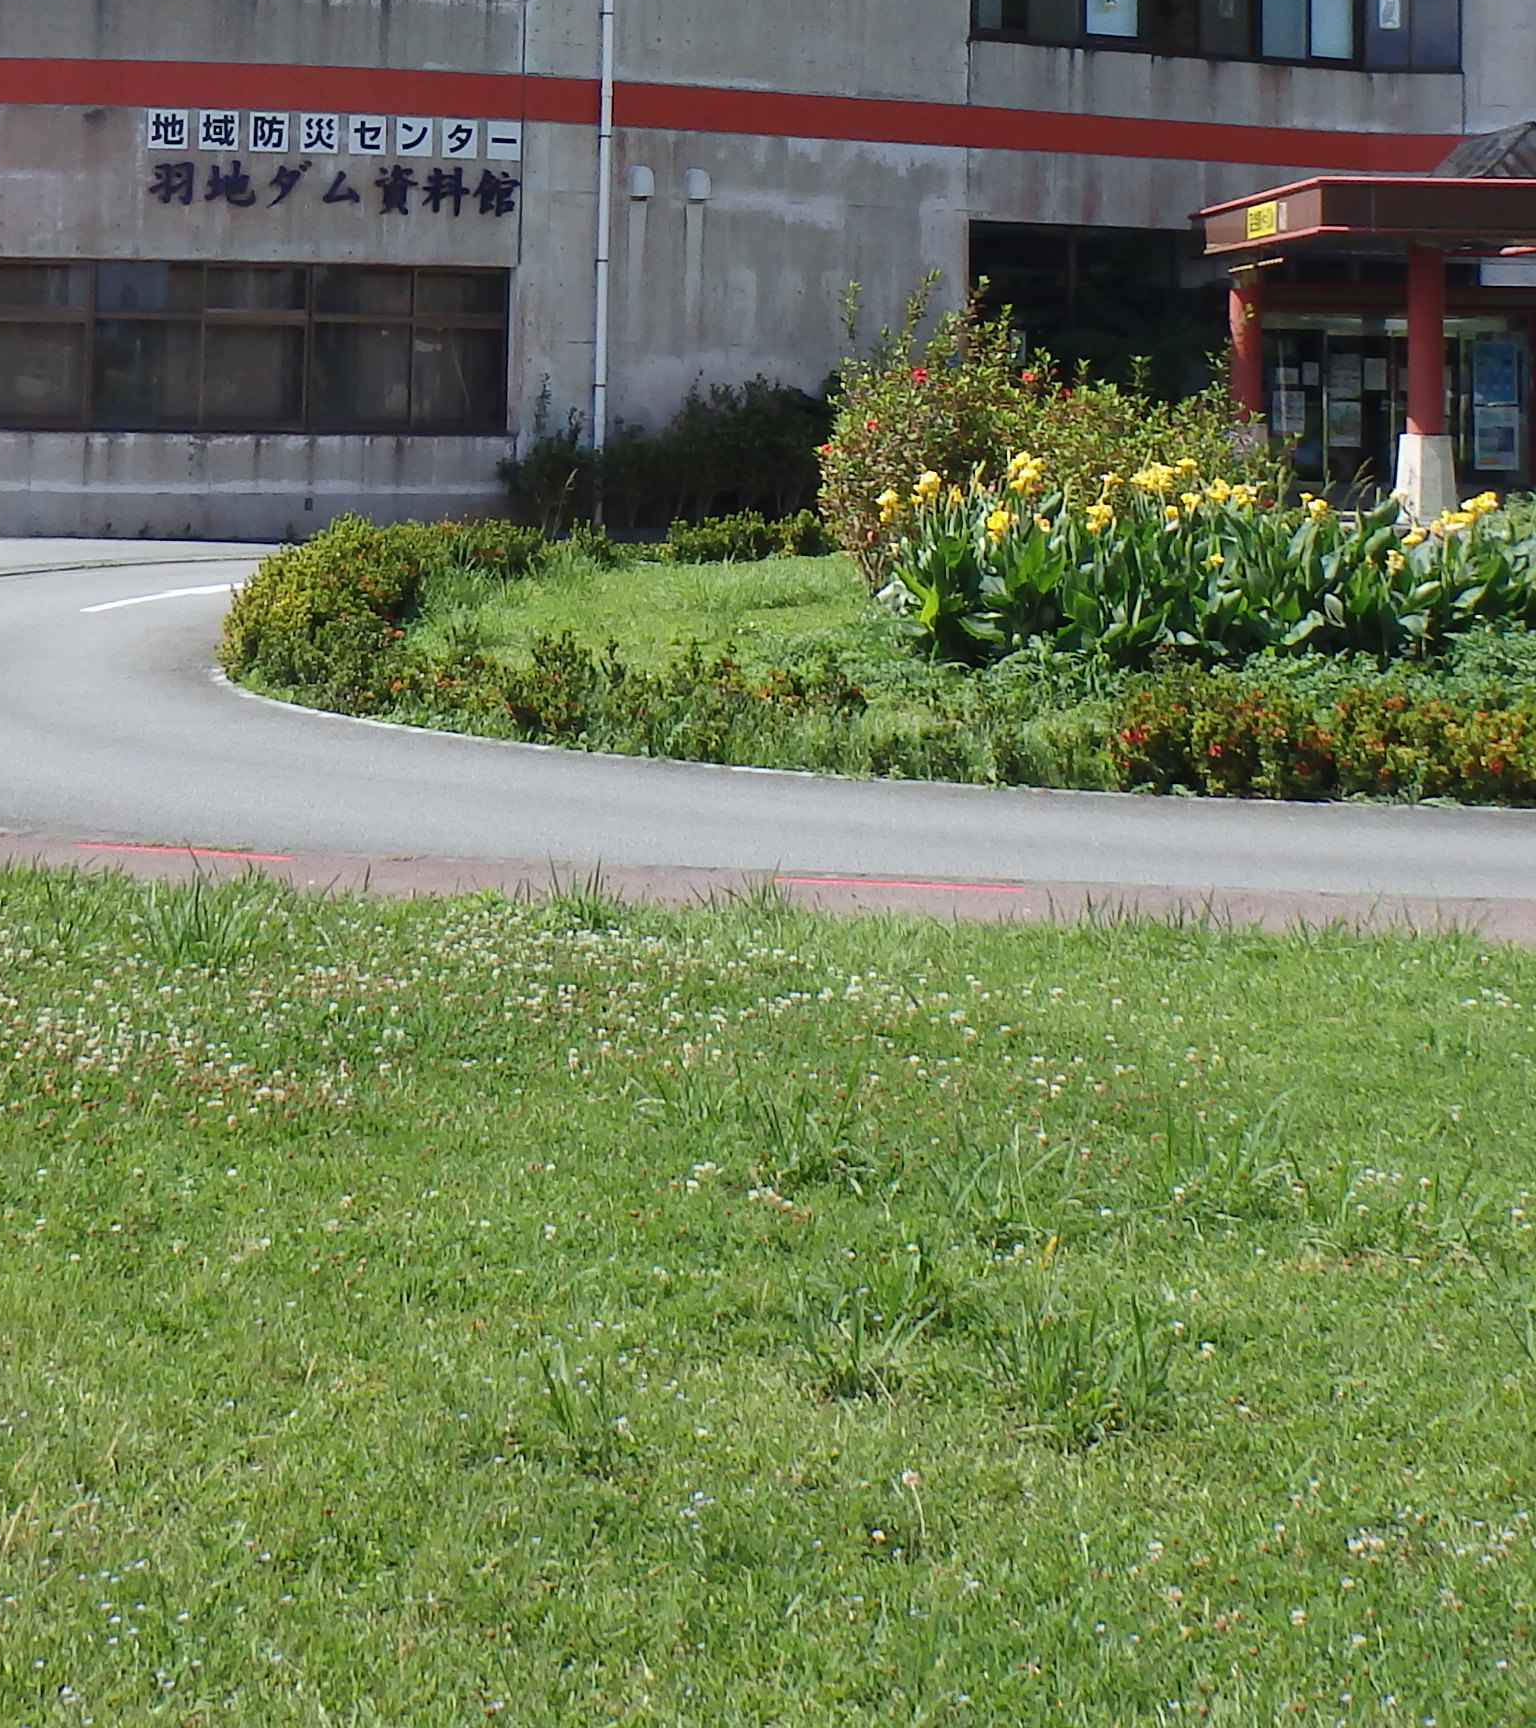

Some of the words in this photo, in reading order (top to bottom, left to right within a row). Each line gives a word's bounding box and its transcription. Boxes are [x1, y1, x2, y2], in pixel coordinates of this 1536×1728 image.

[151, 113, 519, 155] 地域防災センター
[148, 159, 522, 218] 羽地ダム資料館
